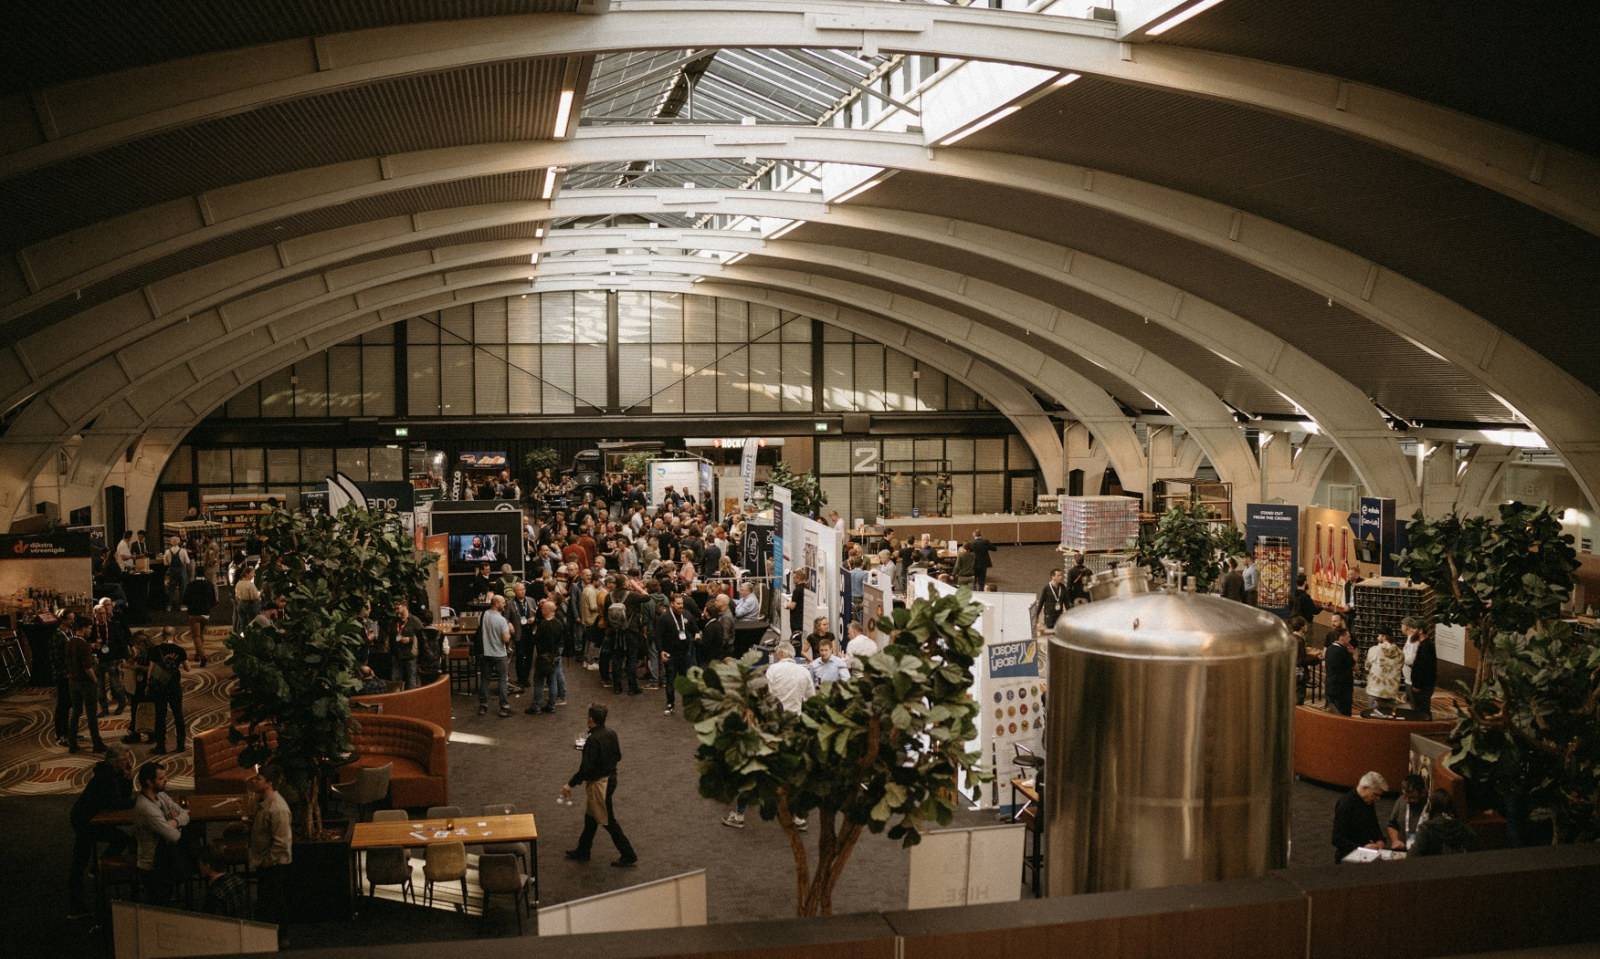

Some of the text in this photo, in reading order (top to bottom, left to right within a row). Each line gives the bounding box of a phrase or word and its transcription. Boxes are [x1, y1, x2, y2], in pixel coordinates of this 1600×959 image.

[853, 447, 878, 472] 2
[30, 542, 53, 550] dijkstra
[30, 547, 66, 555] vereenigde
[991, 643, 1021, 660] jasper
[991, 654, 1017, 671] yeast
